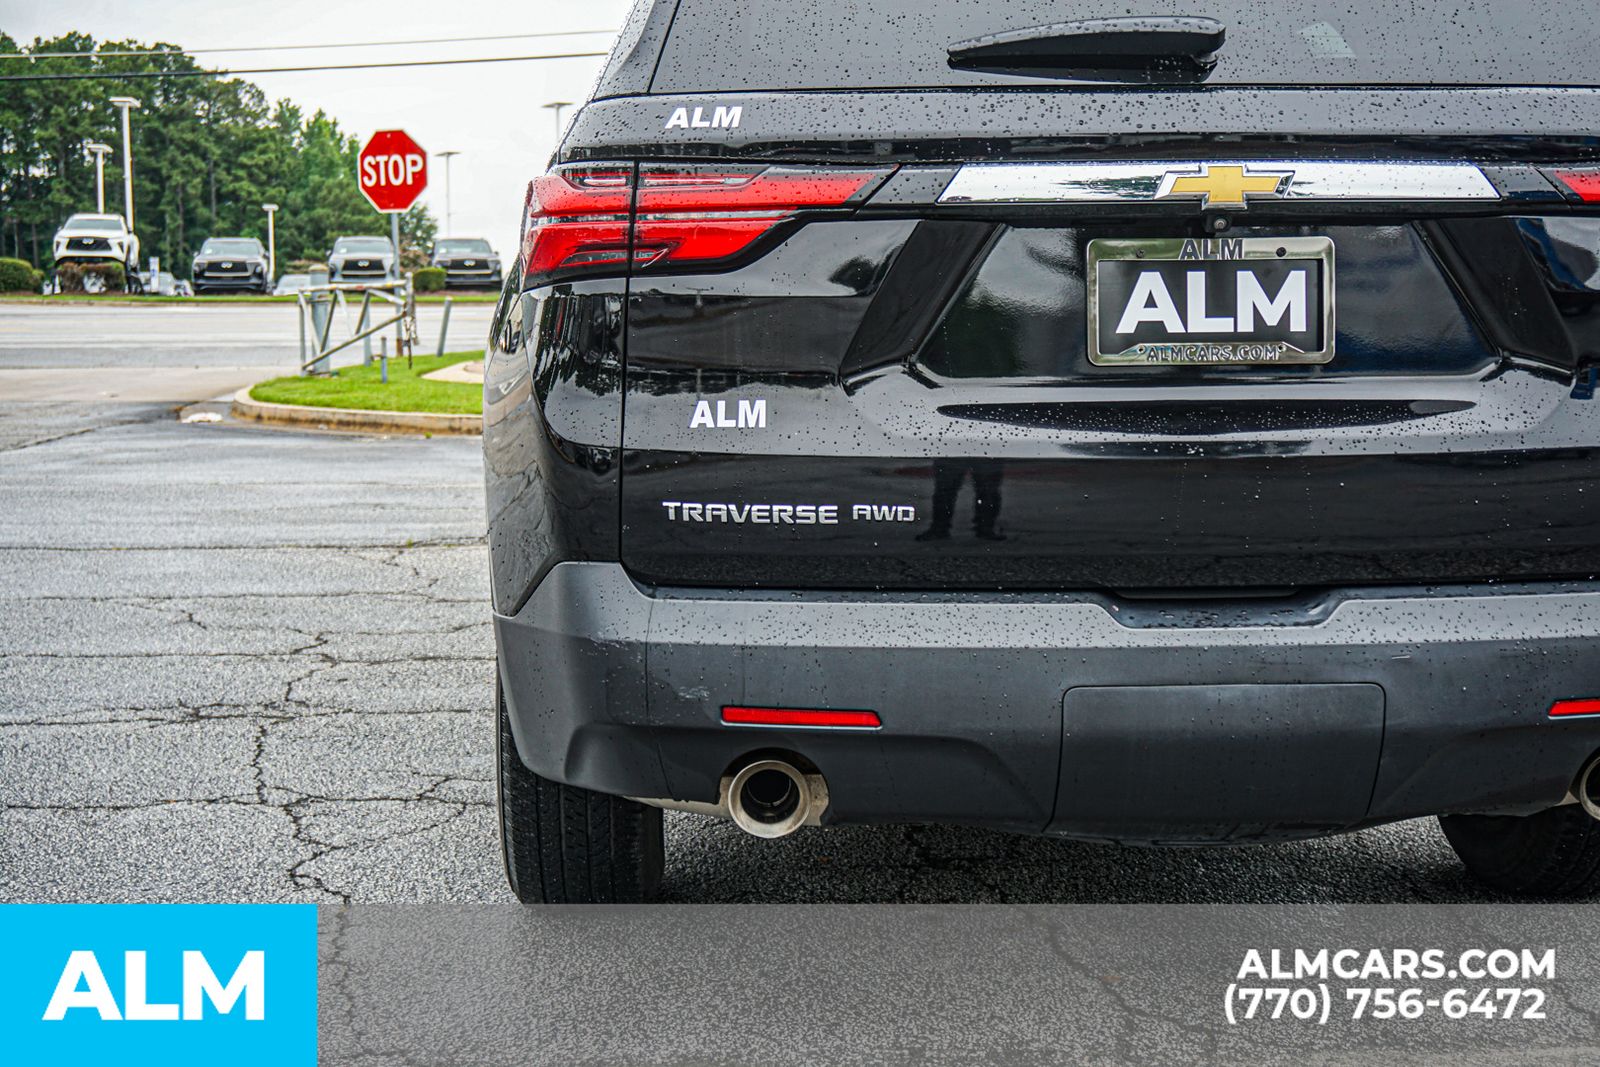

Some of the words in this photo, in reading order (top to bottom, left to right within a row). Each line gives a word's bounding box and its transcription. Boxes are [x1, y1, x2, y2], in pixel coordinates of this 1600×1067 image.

[665, 106, 742, 129] ALM
[363, 153, 424, 187] STOP
[1179, 238, 1245, 260] ALM
[1115, 270, 1307, 333] ALM
[1147, 344, 1279, 361] ALMCARS.COM
[689, 399, 767, 429] ALM
[662, 501, 839, 524] TRAVERSE
[852, 504, 915, 522] AWD
